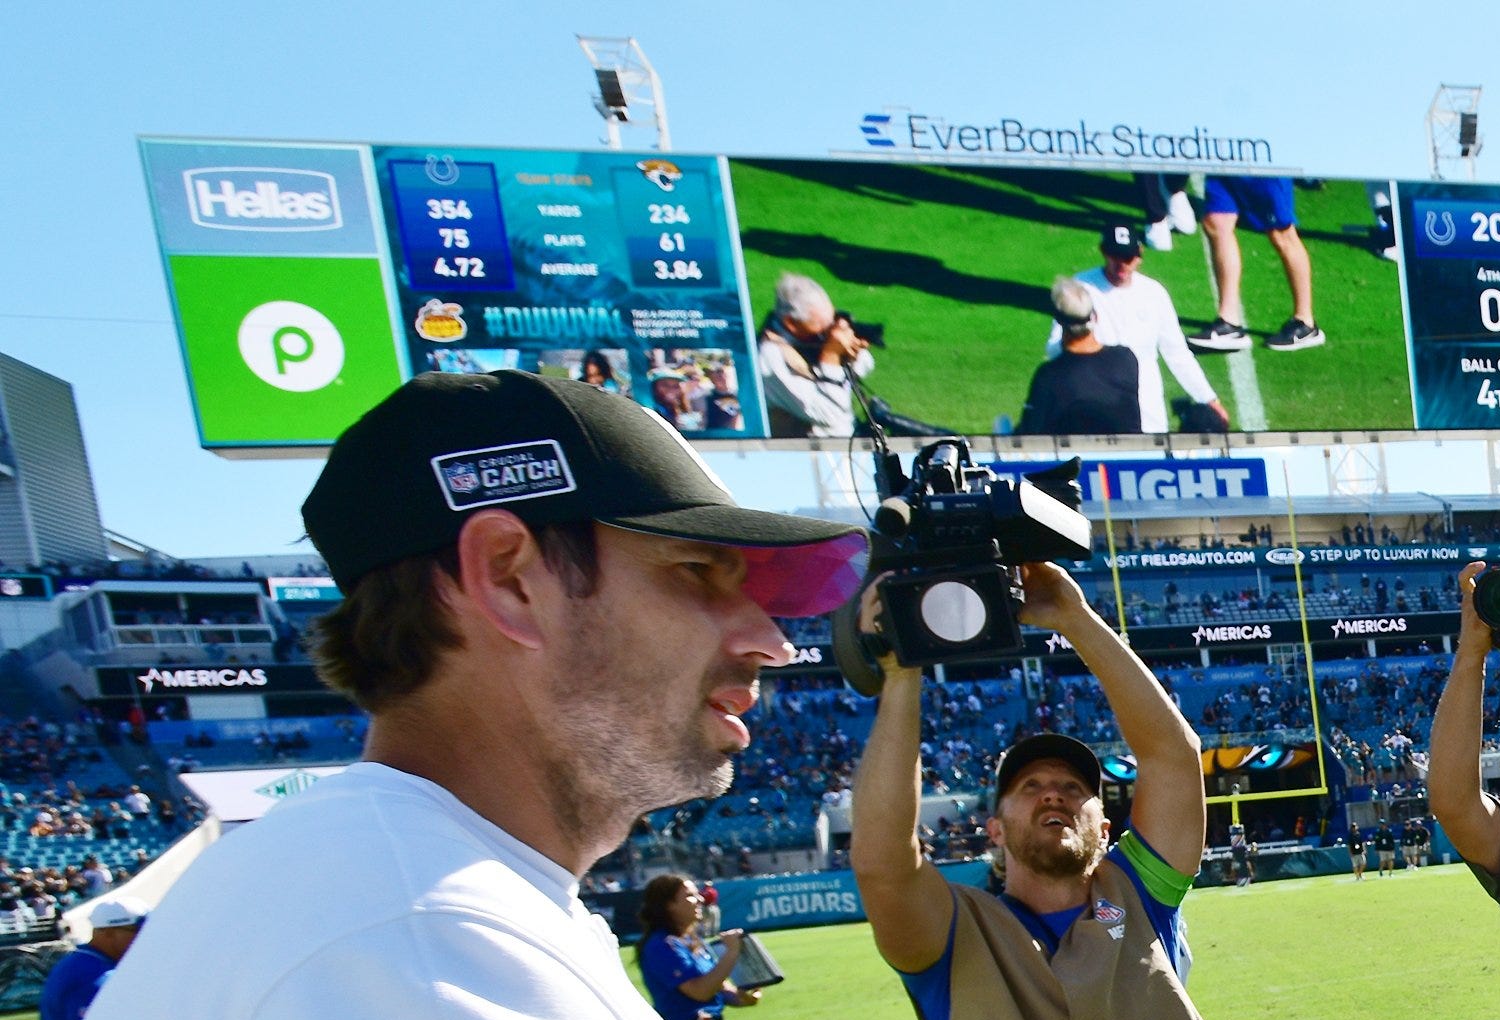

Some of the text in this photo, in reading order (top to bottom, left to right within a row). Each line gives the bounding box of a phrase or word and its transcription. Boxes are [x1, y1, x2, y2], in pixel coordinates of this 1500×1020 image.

[907, 114, 1272, 163] EverBank Stadium
[196, 180, 333, 220] Hellas
[426, 199, 691, 225] 354 YARDS 234
[438, 228, 686, 252] 75 PLAYS 61
[433, 257, 702, 281] 4.72 AVERAGE 3.84
[1476, 266, 1500, 282] 4TH
[1460, 358, 1496, 373] BALL
[478, 451, 536, 469] CRUCIAL
[481, 459, 562, 488] CATCH
[1089, 469, 1251, 501] LIGHT
[1103, 551, 1256, 569] VISIT FIELDSAUTO.COM
[1311, 549, 1343, 562] STEP
[1345, 549, 1361, 561] UP
[1364, 548, 1380, 561] TO
[1384, 548, 1429, 560] LUXURY
[1432, 547, 1459, 560] NOW
[1192, 624, 1272, 646] AMERICAS
[1331, 618, 1407, 639] AMERICAS
[137, 668, 268, 693] AMERICAS
[756, 879, 842, 895] JACKSONVILLE
[746, 892, 857, 922] JAGUARS
